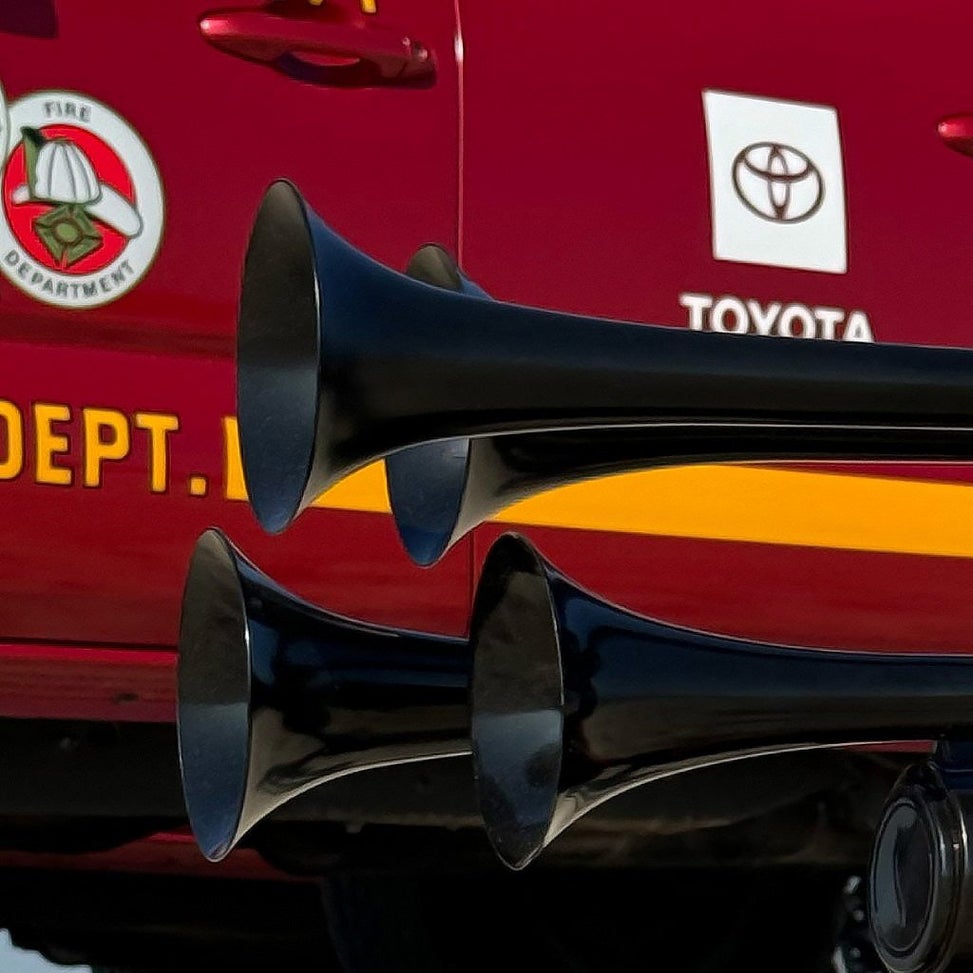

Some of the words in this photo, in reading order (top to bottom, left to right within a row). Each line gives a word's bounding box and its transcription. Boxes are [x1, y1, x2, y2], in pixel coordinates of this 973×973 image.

[44, 101, 91, 123] FIRE
[4, 249, 136, 298] DEPARTMENT
[679, 294, 874, 342] TOYOTA
